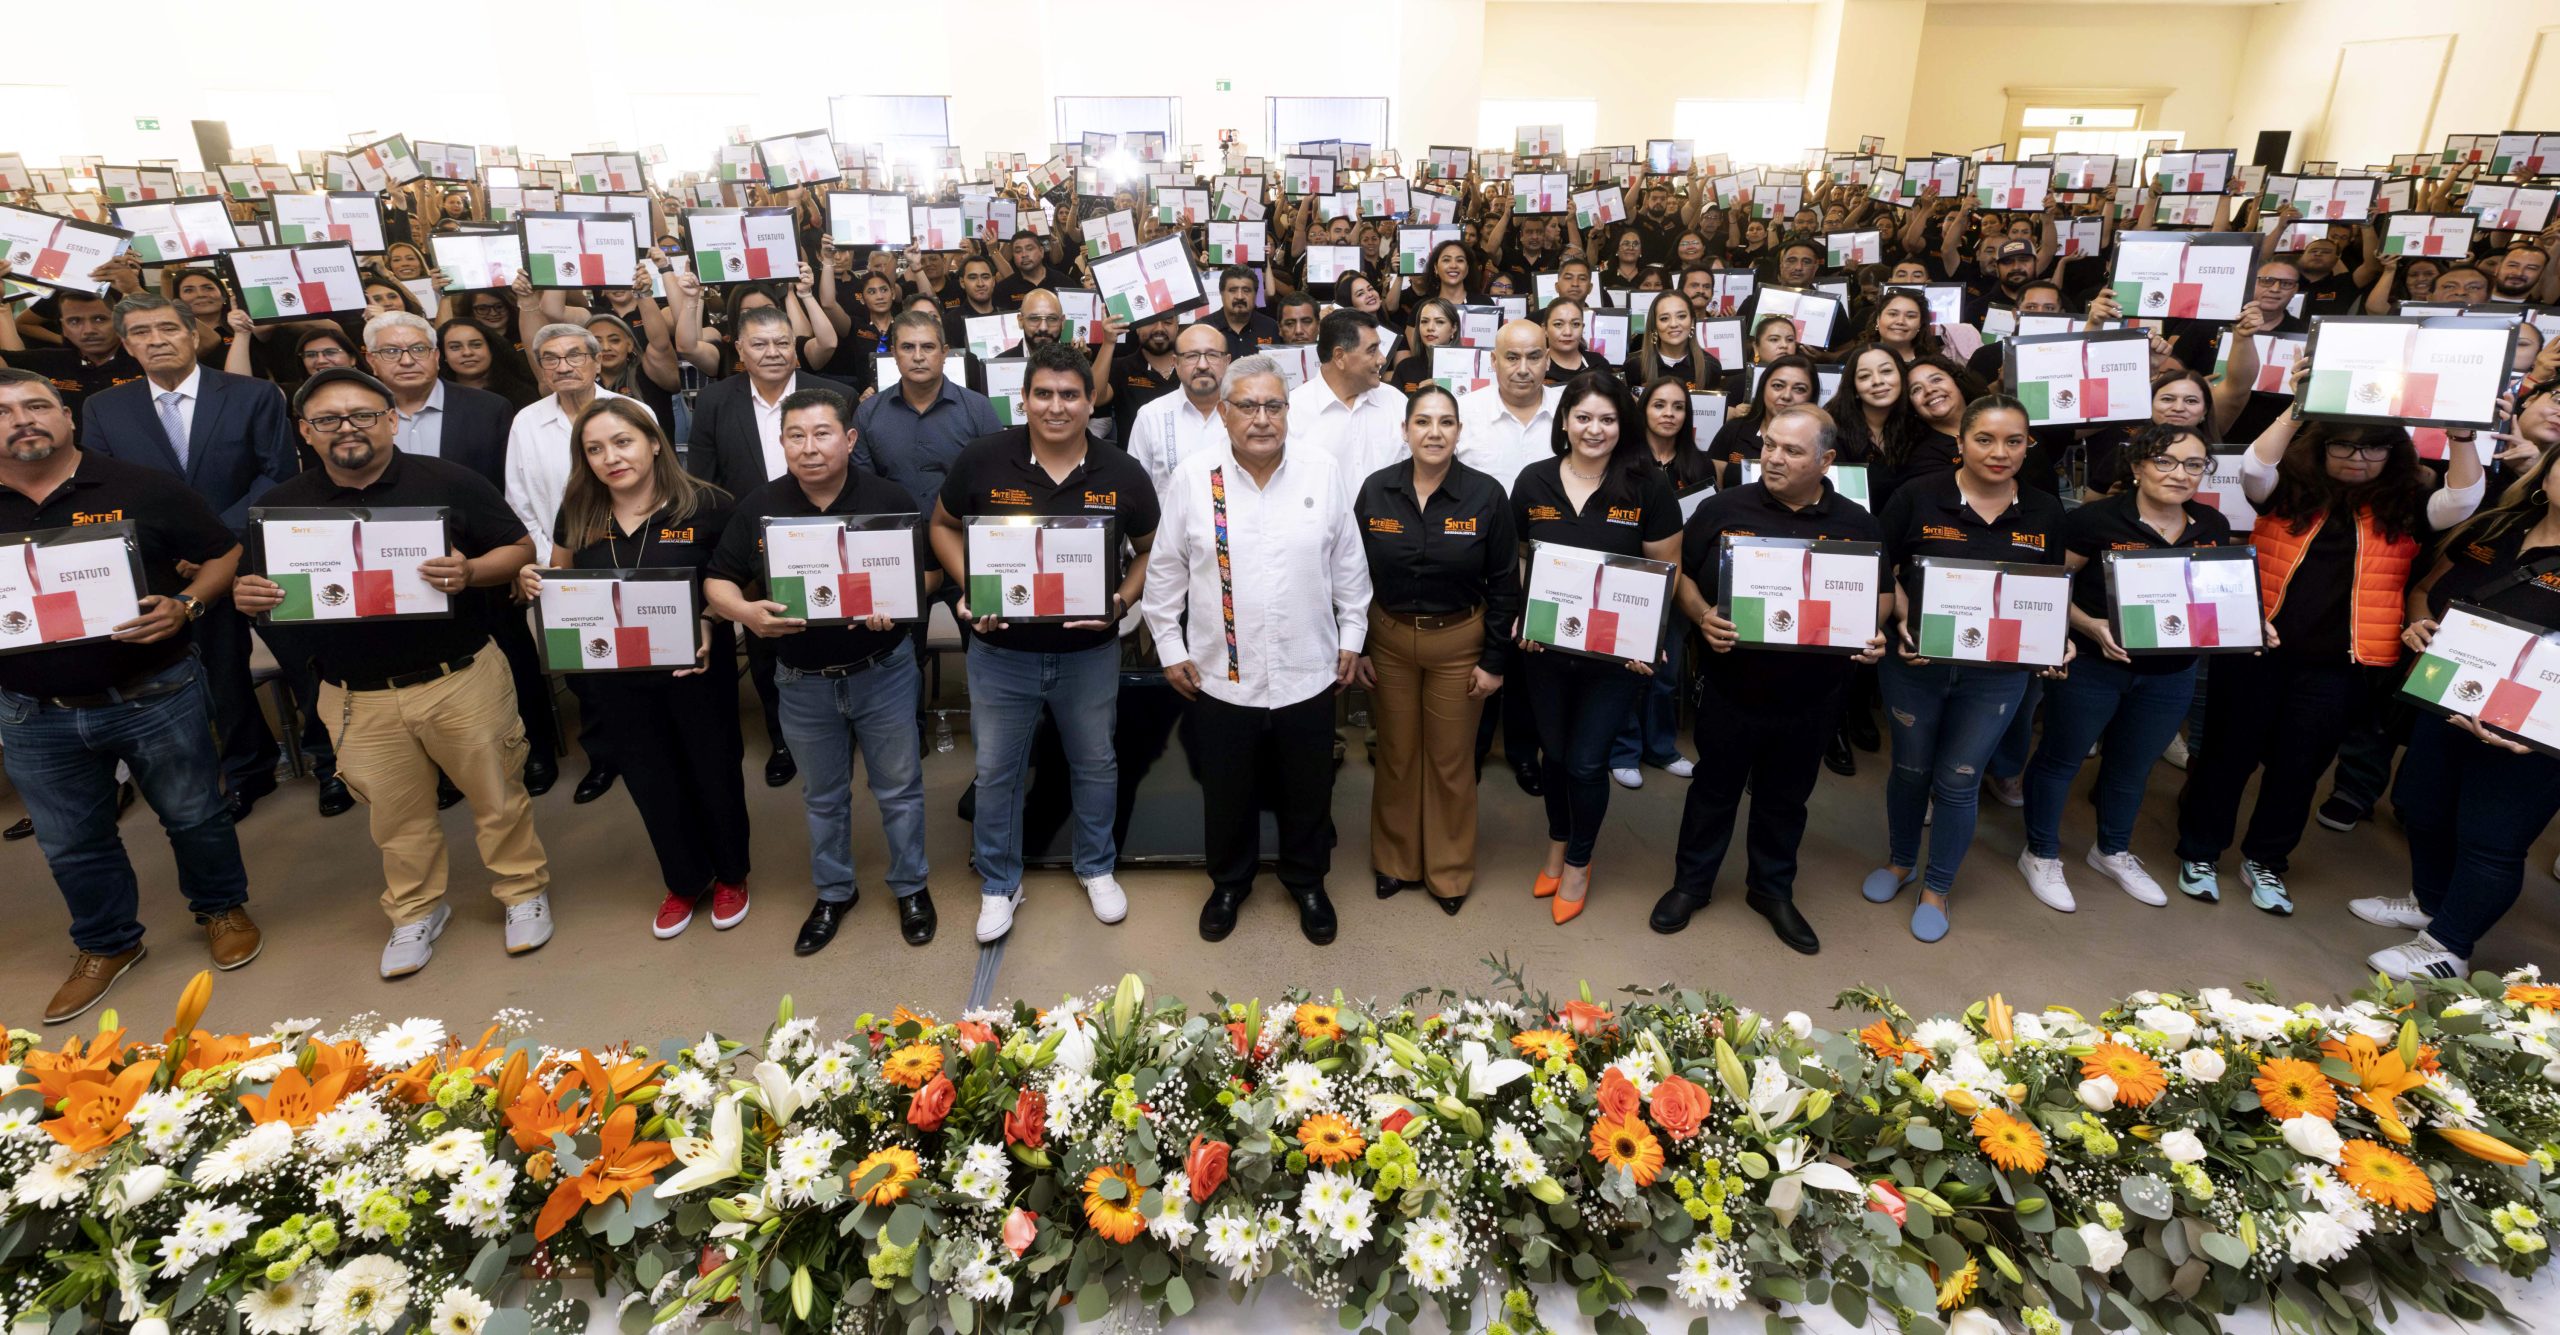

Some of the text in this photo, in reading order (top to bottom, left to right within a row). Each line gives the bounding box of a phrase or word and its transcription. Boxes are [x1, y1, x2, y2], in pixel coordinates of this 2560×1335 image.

[757, 233, 784, 241] ESTATUTO
[313, 266, 344, 274] ESTATUTO
[2198, 266, 2235, 274] ESTATUTO
[2430, 353, 2484, 365] ESTATUTO
[2101, 363, 2136, 372] ESTATUTO
[1692, 409, 1717, 417] ESTATUTO
[2212, 475, 2240, 485] ESTATU
[381, 547, 427, 557] ESTATUTO
[862, 557, 900, 567] ESTATUTO
[1057, 554, 1092, 563] ESTATUTO
[60, 567, 110, 582] ESTATUTO
[1825, 580, 1864, 592] ESTATUTO
[1613, 592, 1649, 607] ESTATUTO
[637, 606, 676, 615] ESTATUTO
[2014, 600, 2053, 611] ESTATUTO
[2539, 669, 2560, 686] ESTA
